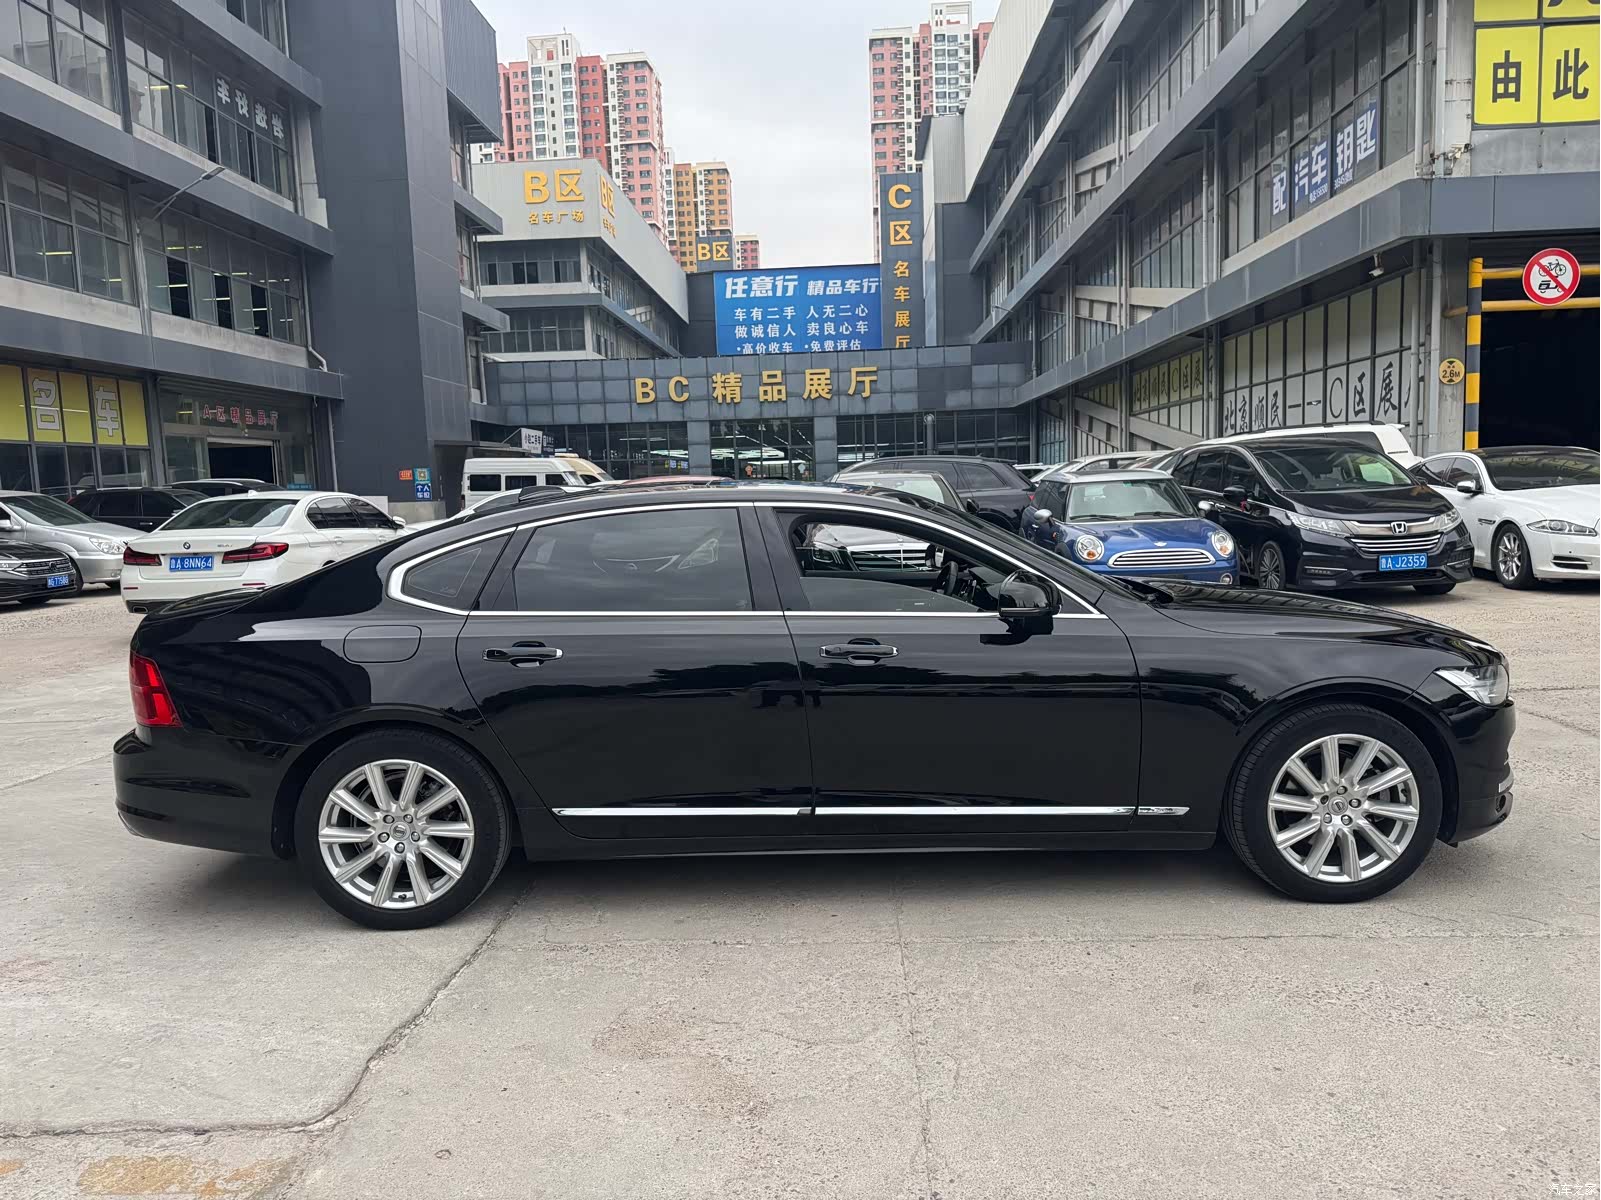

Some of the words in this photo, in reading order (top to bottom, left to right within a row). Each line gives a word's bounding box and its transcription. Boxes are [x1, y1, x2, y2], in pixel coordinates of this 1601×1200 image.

[1491, 47, 1590, 103] 由此
[524, 168, 585, 204] B区
[528, 210, 585, 225] 名车广场
[697, 241, 731, 261] B区
[725, 275, 798, 299] 任意行
[806, 278, 879, 296] 精品车行
[734, 306, 796, 322] 车有二手
[806, 304, 869, 319] 人无二心
[734, 324, 796, 339] 做诚信人
[806, 320, 869, 336] 卖良心车
[1442, 369, 1461, 379] 2.6M
[32, 377, 120, 437] 名车
